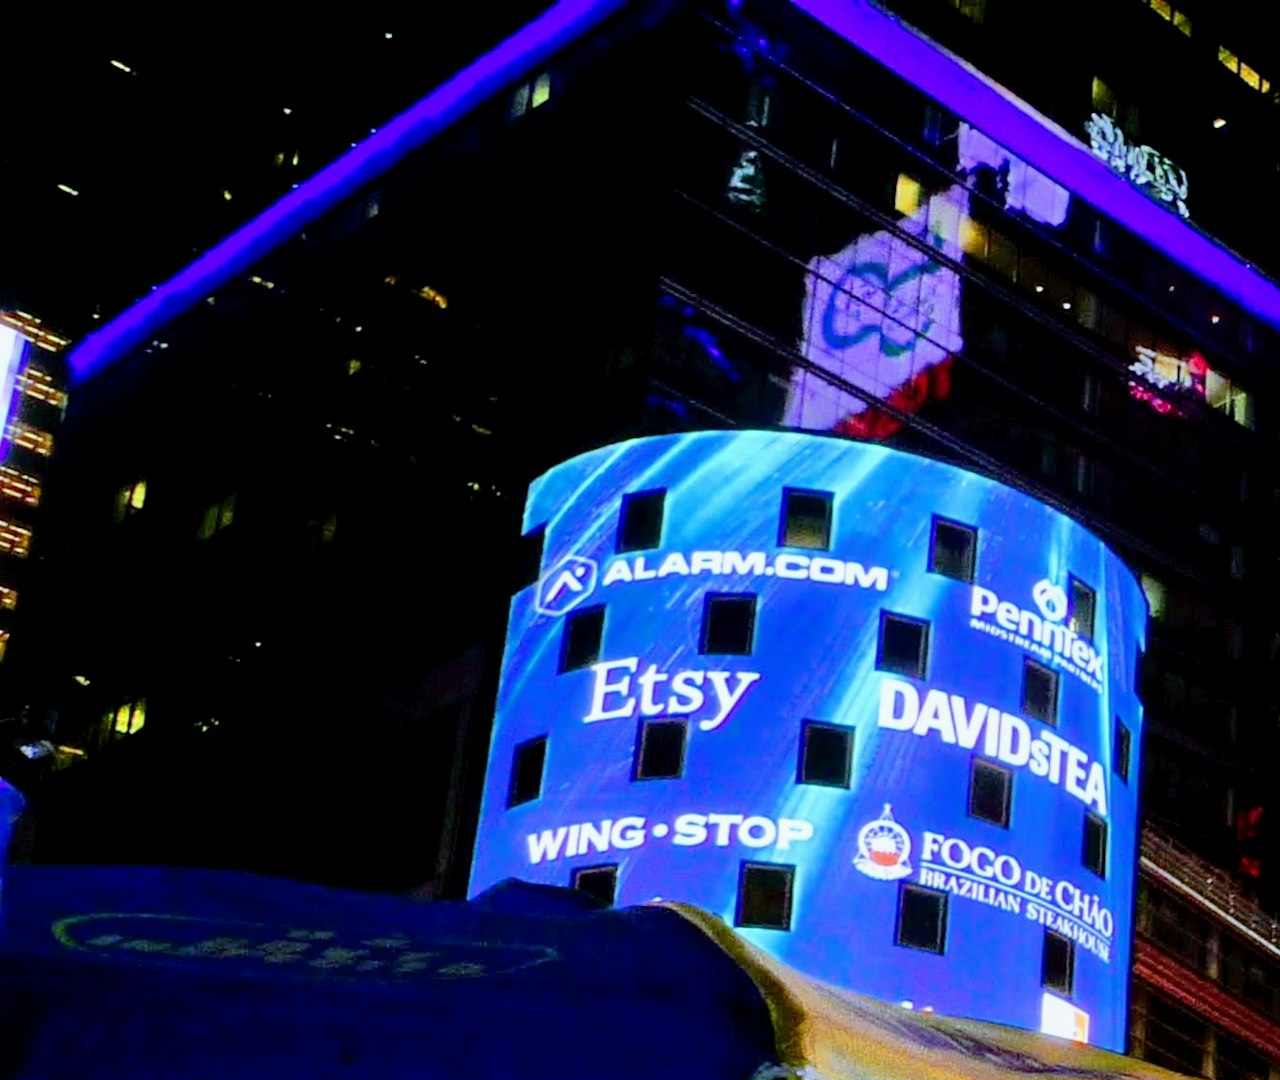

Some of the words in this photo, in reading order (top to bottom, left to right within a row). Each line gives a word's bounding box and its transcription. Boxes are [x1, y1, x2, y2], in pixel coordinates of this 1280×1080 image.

[601, 550, 891, 592] ALARM.COM
[583, 654, 760, 731] Etsy
[921, 831, 1022, 886] FOGO
[1024, 869, 1054, 901] DE
[919, 866, 1022, 914] BRAZILIAN
[1025, 901, 1111, 963] STEAKHOUSE
